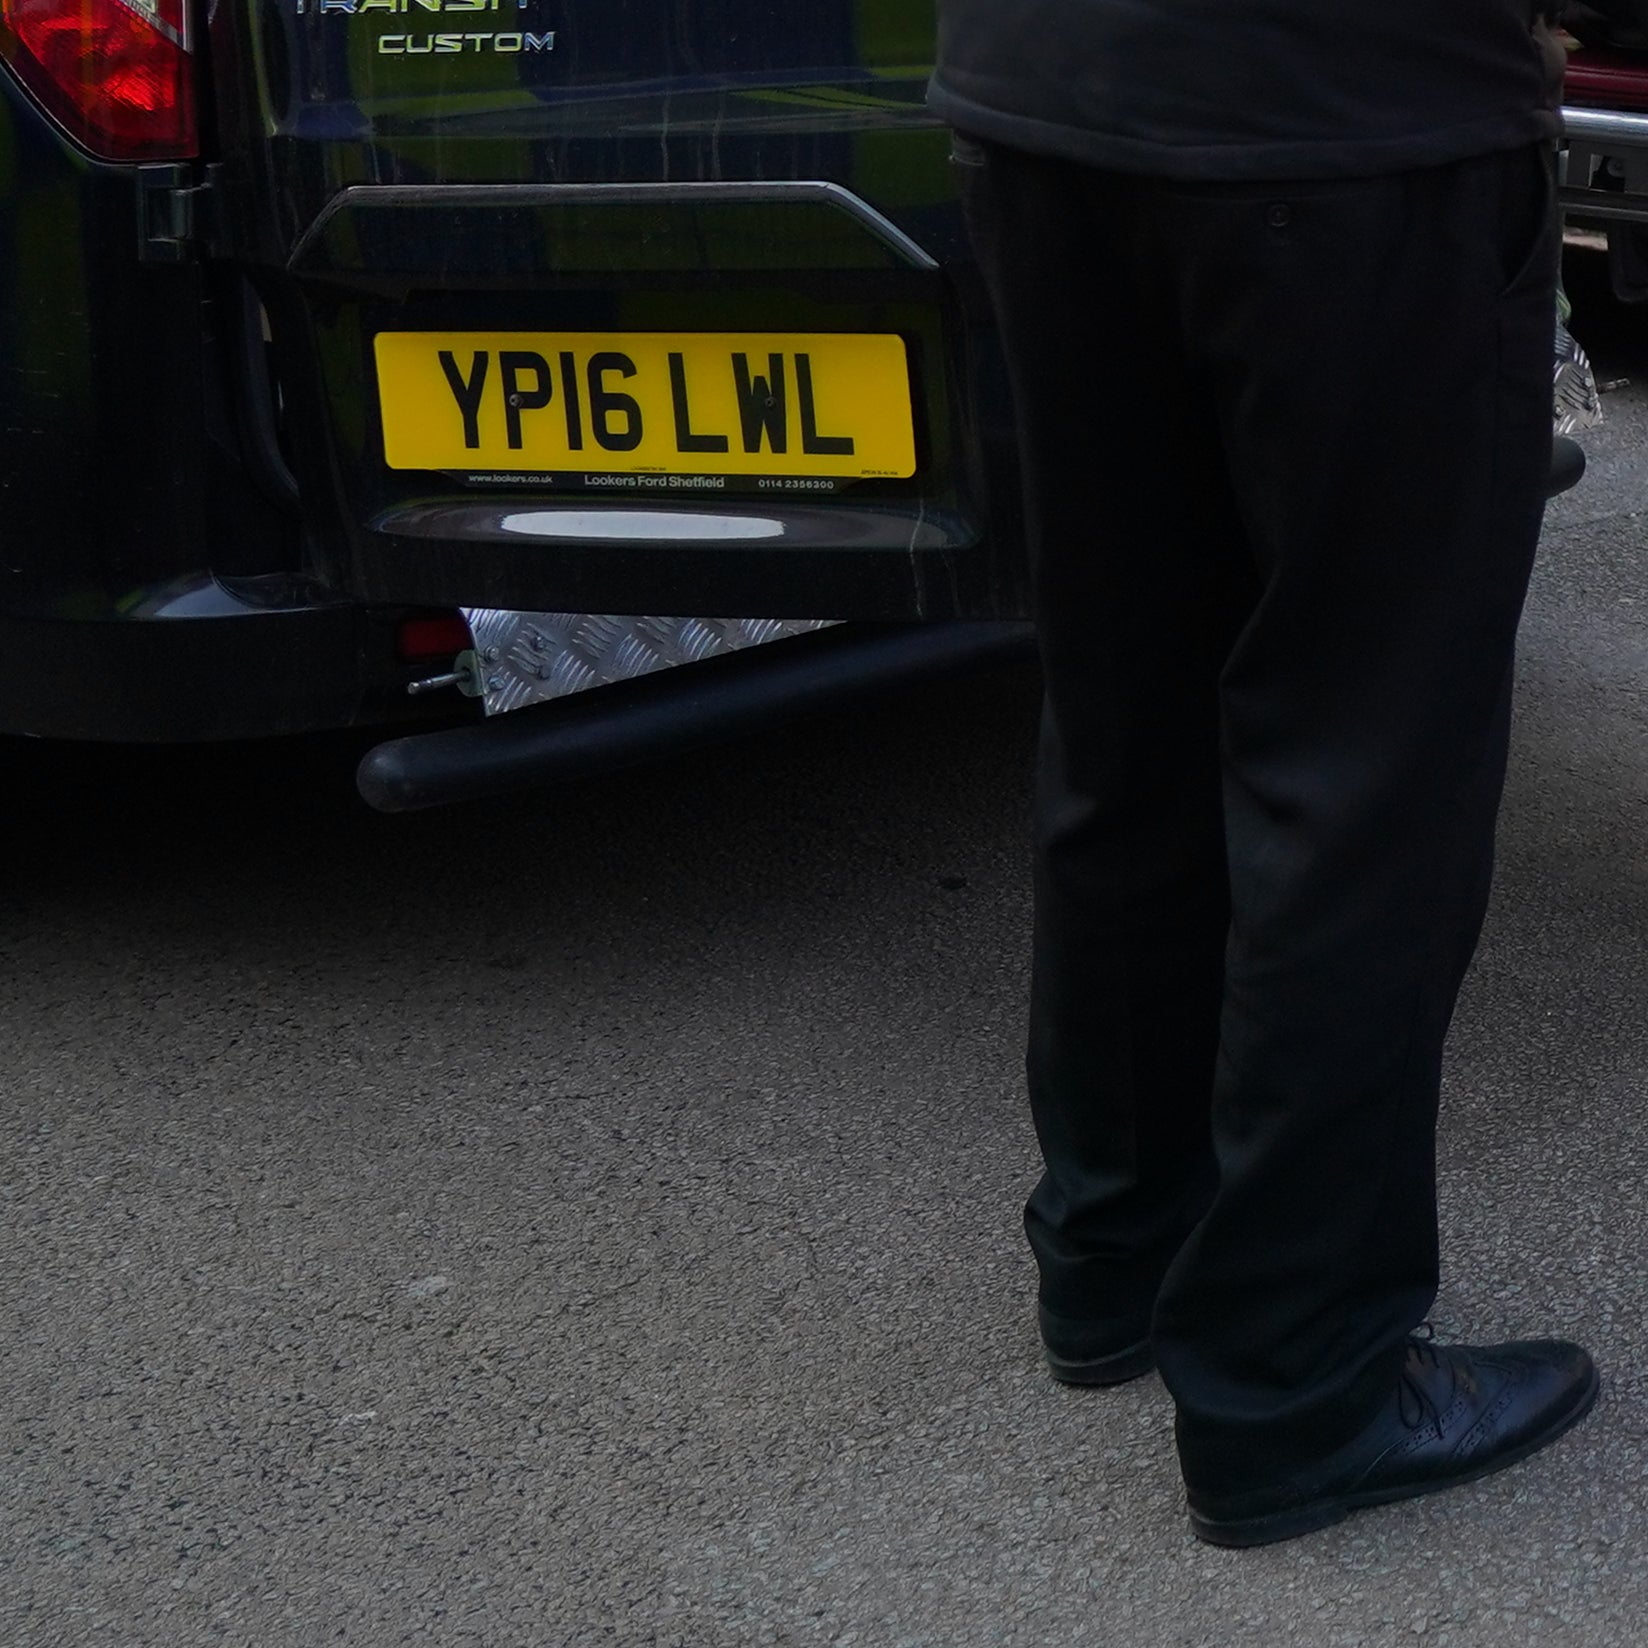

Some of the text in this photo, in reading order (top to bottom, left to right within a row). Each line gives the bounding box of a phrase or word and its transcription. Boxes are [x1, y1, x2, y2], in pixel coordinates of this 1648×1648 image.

[378, 31, 556, 54] CUSTOM
[438, 350, 854, 456] YP16 LWL
[584, 475, 635, 487] Lookers
[637, 476, 667, 487] Ford
[668, 476, 725, 489] Sheffield
[758, 478, 783, 488] 0114
